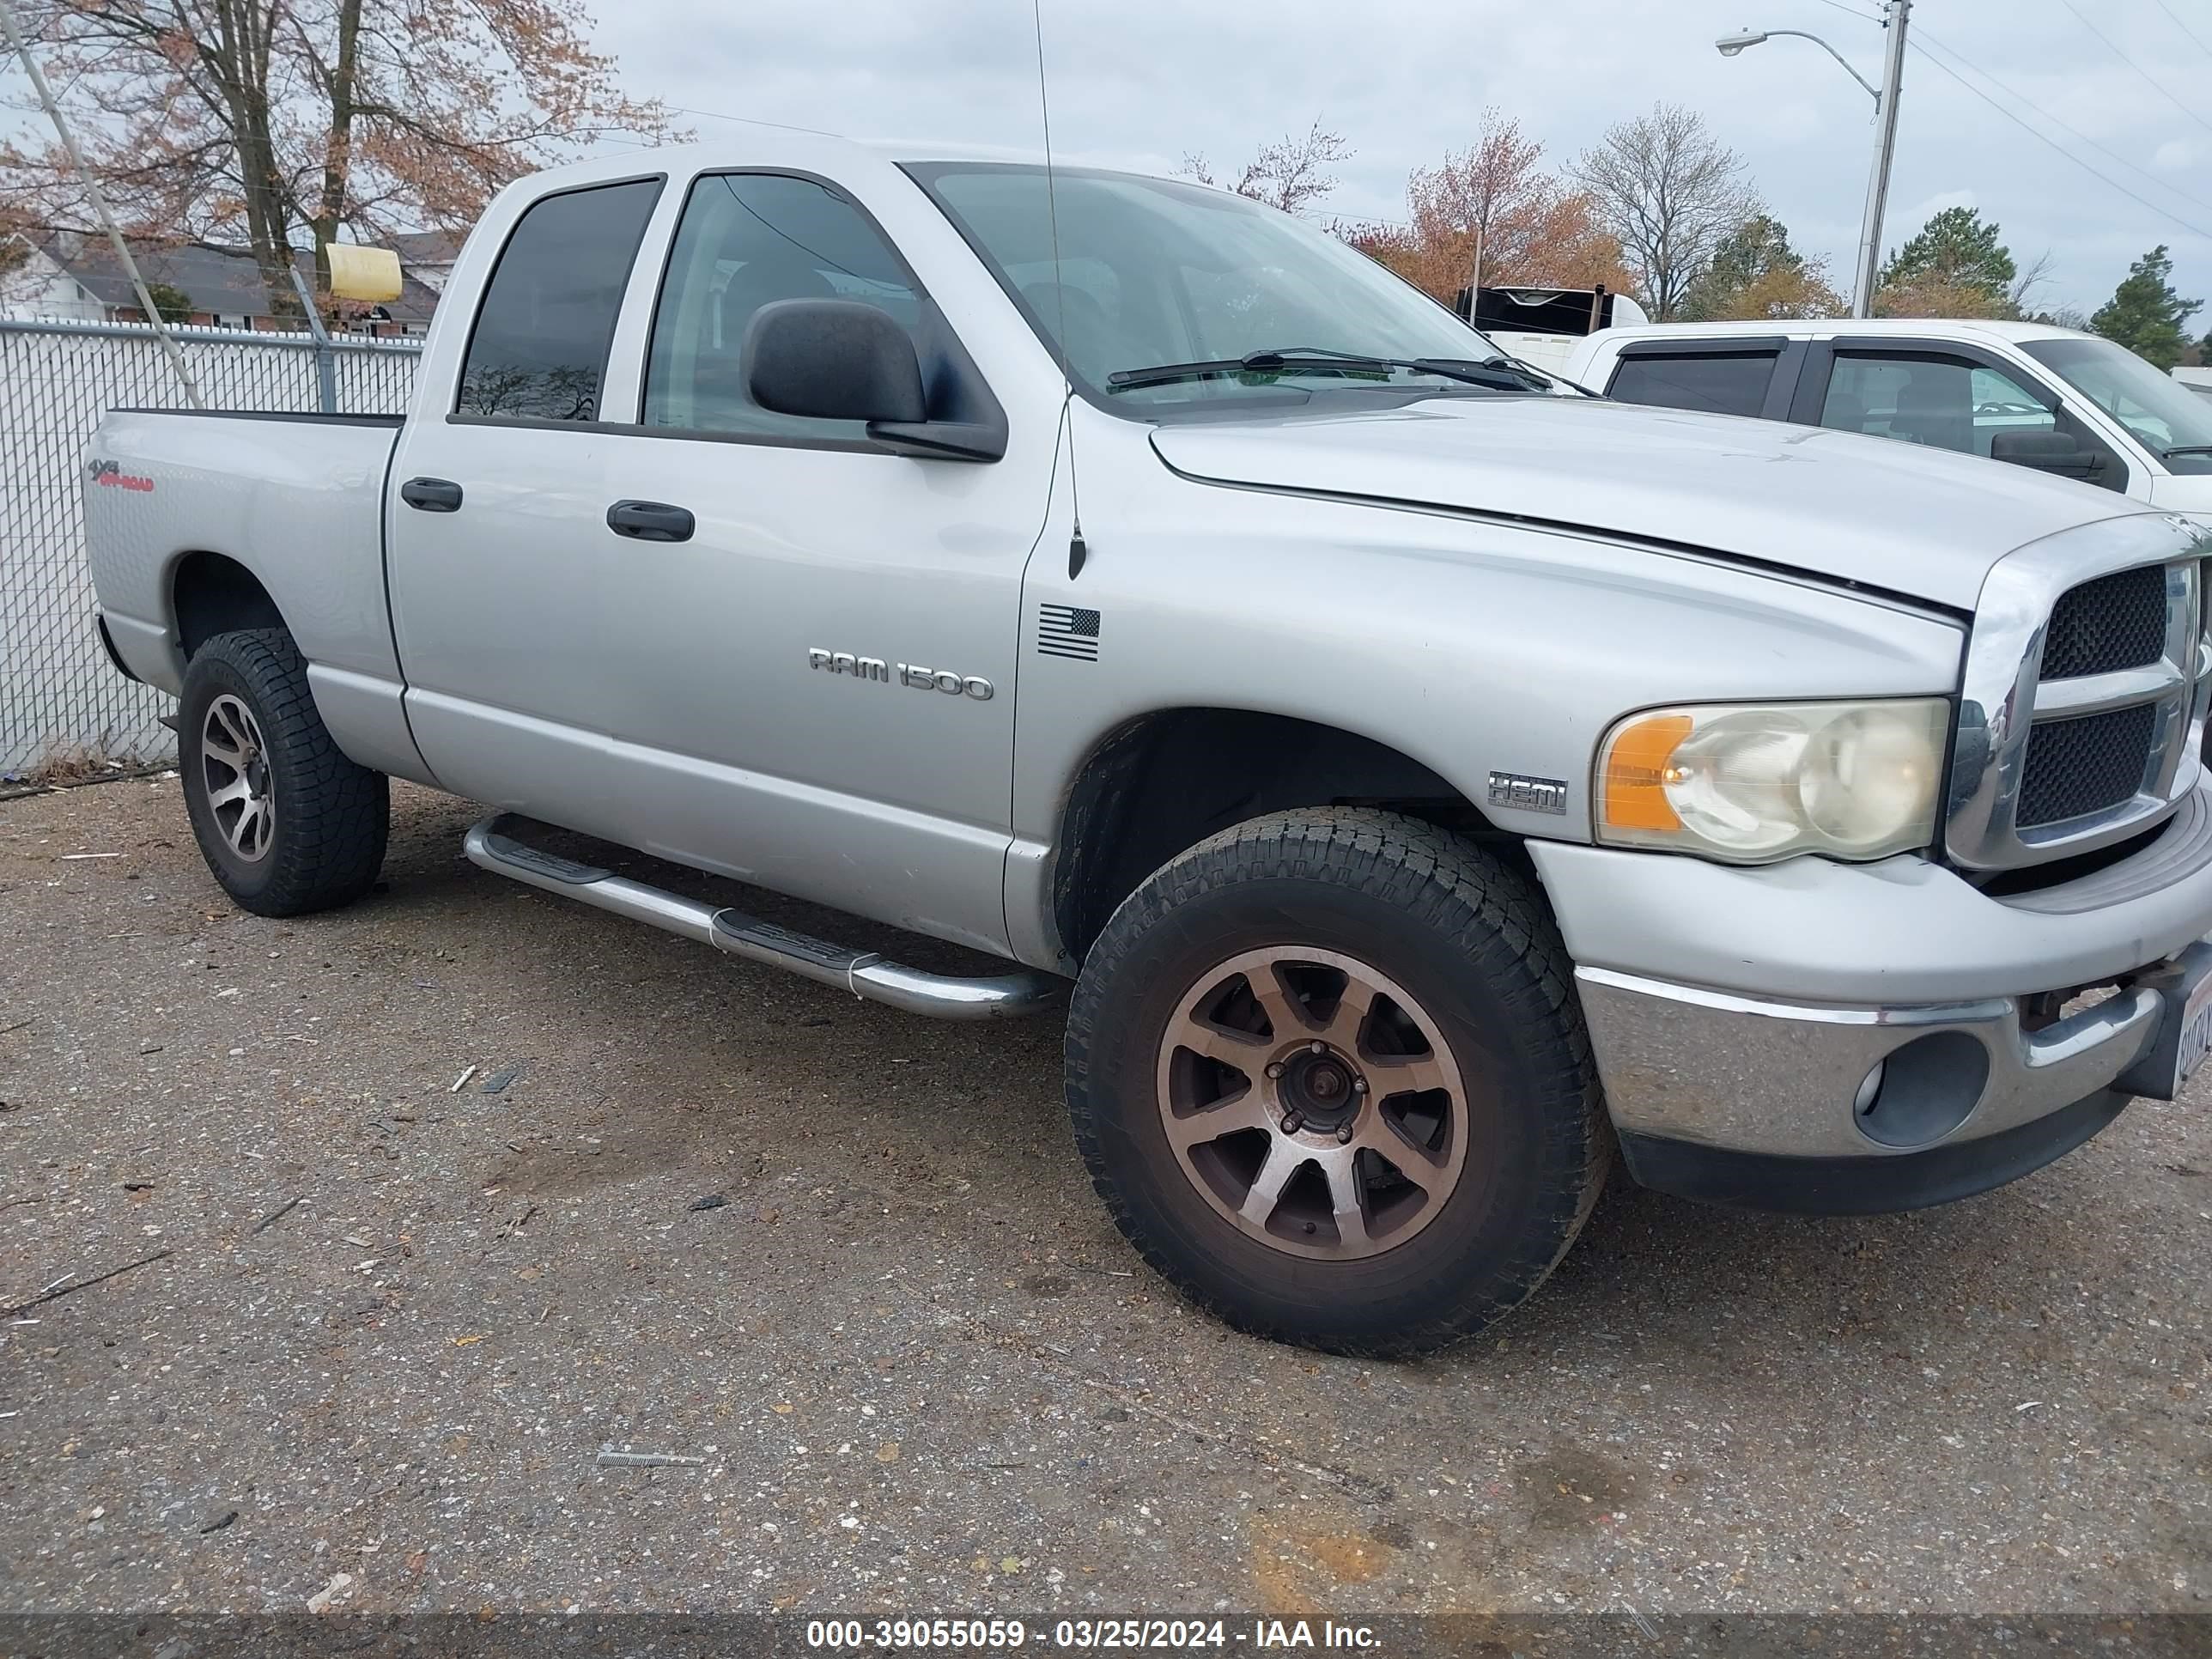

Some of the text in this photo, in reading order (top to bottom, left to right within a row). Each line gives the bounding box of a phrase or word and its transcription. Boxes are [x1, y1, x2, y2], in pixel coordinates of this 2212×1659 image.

[809, 647, 994, 701] RAM 1500
[1488, 776, 1567, 809] HEMI
